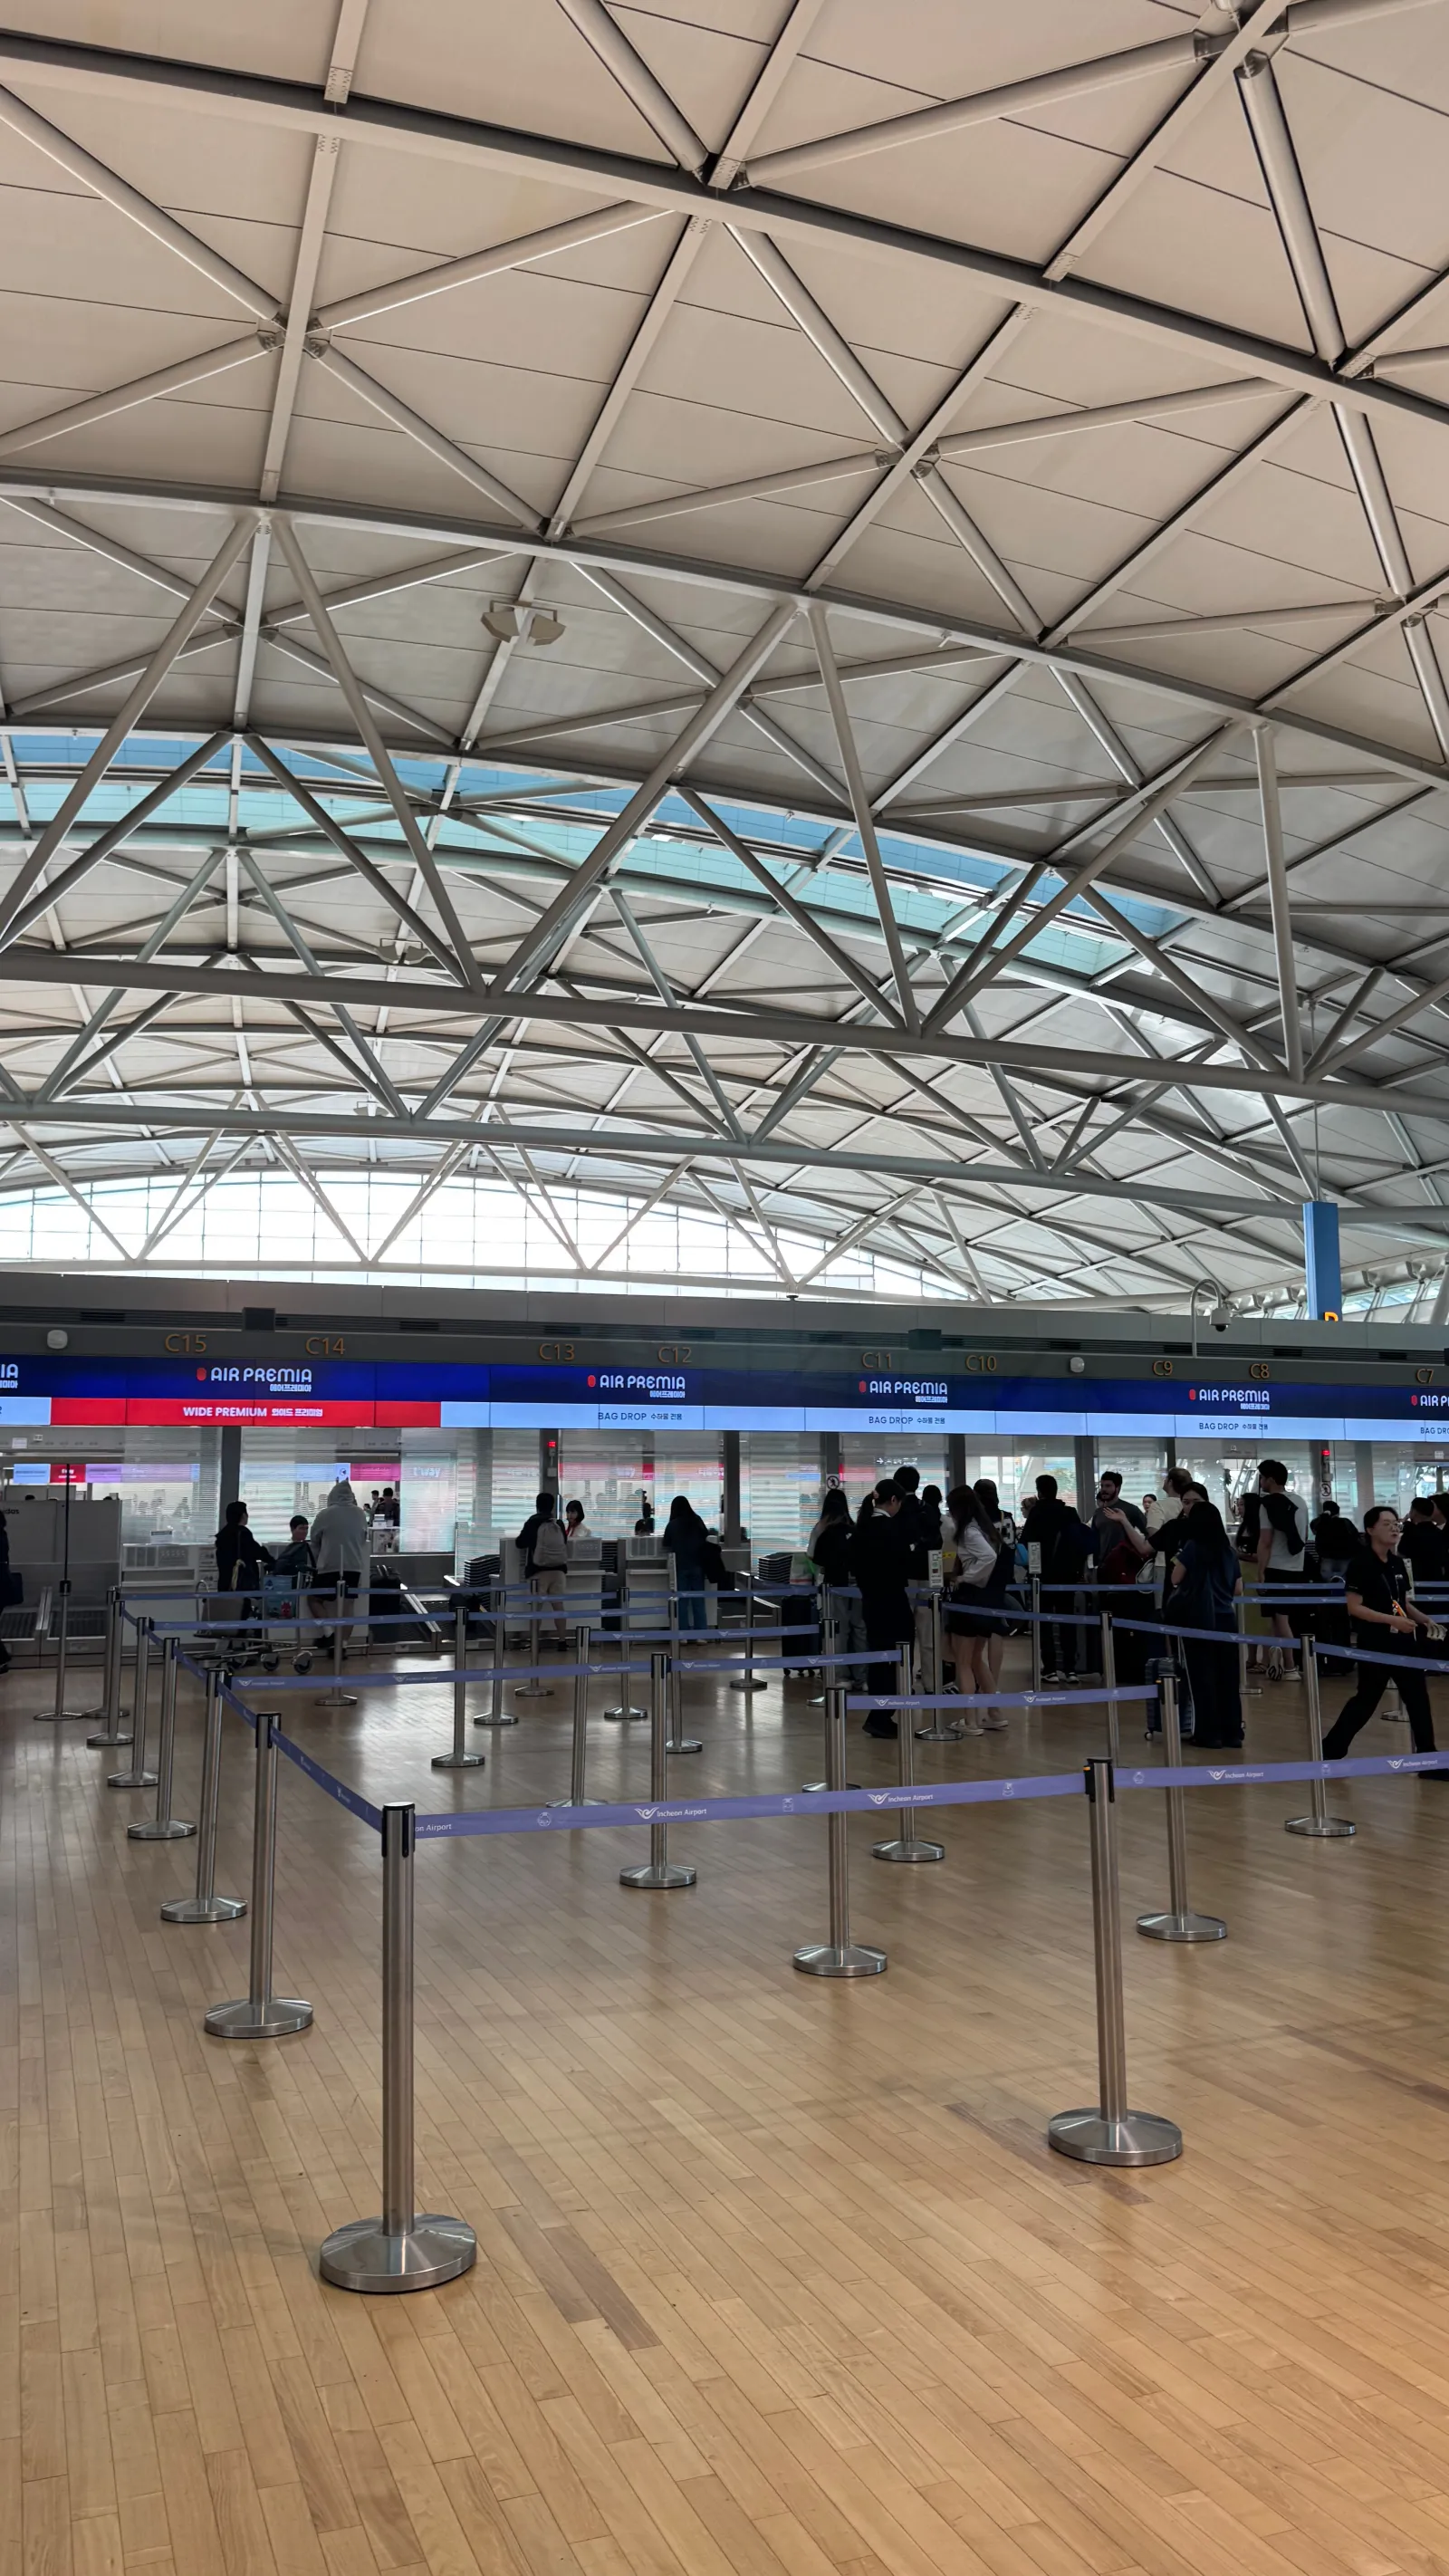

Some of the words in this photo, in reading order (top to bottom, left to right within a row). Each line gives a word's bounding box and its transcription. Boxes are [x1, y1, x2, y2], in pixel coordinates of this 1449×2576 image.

[164, 1333, 207, 1352] C15
[305, 1337, 346, 1355] C14
[539, 1343, 575, 1360] C13
[658, 1346, 692, 1363] C12
[862, 1351, 892, 1369] C11
[965, 1354, 997, 1371] C10
[210, 1367, 240, 1381] AIR
[243, 1368, 312, 1383] PREMIA
[1153, 1360, 1174, 1376] C9
[1250, 1363, 1271, 1379] C8
[600, 1374, 624, 1389] AIR
[627, 1375, 686, 1389] PREMIA
[1415, 1368, 1435, 1384] C7
[869, 1380, 892, 1394] AIR
[894, 1381, 948, 1395] PREMIA
[1198, 1389, 1220, 1401] AIR
[1221, 1389, 1271, 1403] PREMIA
[1420, 1395, 1439, 1407] AIR
[1441, 1396, 1449, 1407] P
[183, 1407, 213, 1417] WIDE
[215, 1407, 267, 1418] PREMIUM
[598, 1411, 619, 1420] BAG
[620, 1412, 647, 1421] DROP
[868, 1416, 888, 1424] BAG
[888, 1417, 914, 1425] DROP
[1198, 1422, 1216, 1430] BAG
[1420, 1427, 1436, 1435] BAG
[913, 1793, 935, 1802] Airport
[657, 1808, 682, 1817] Incheon
[684, 1807, 707, 1817] Airport
[426, 1823, 452, 1832] Airport
